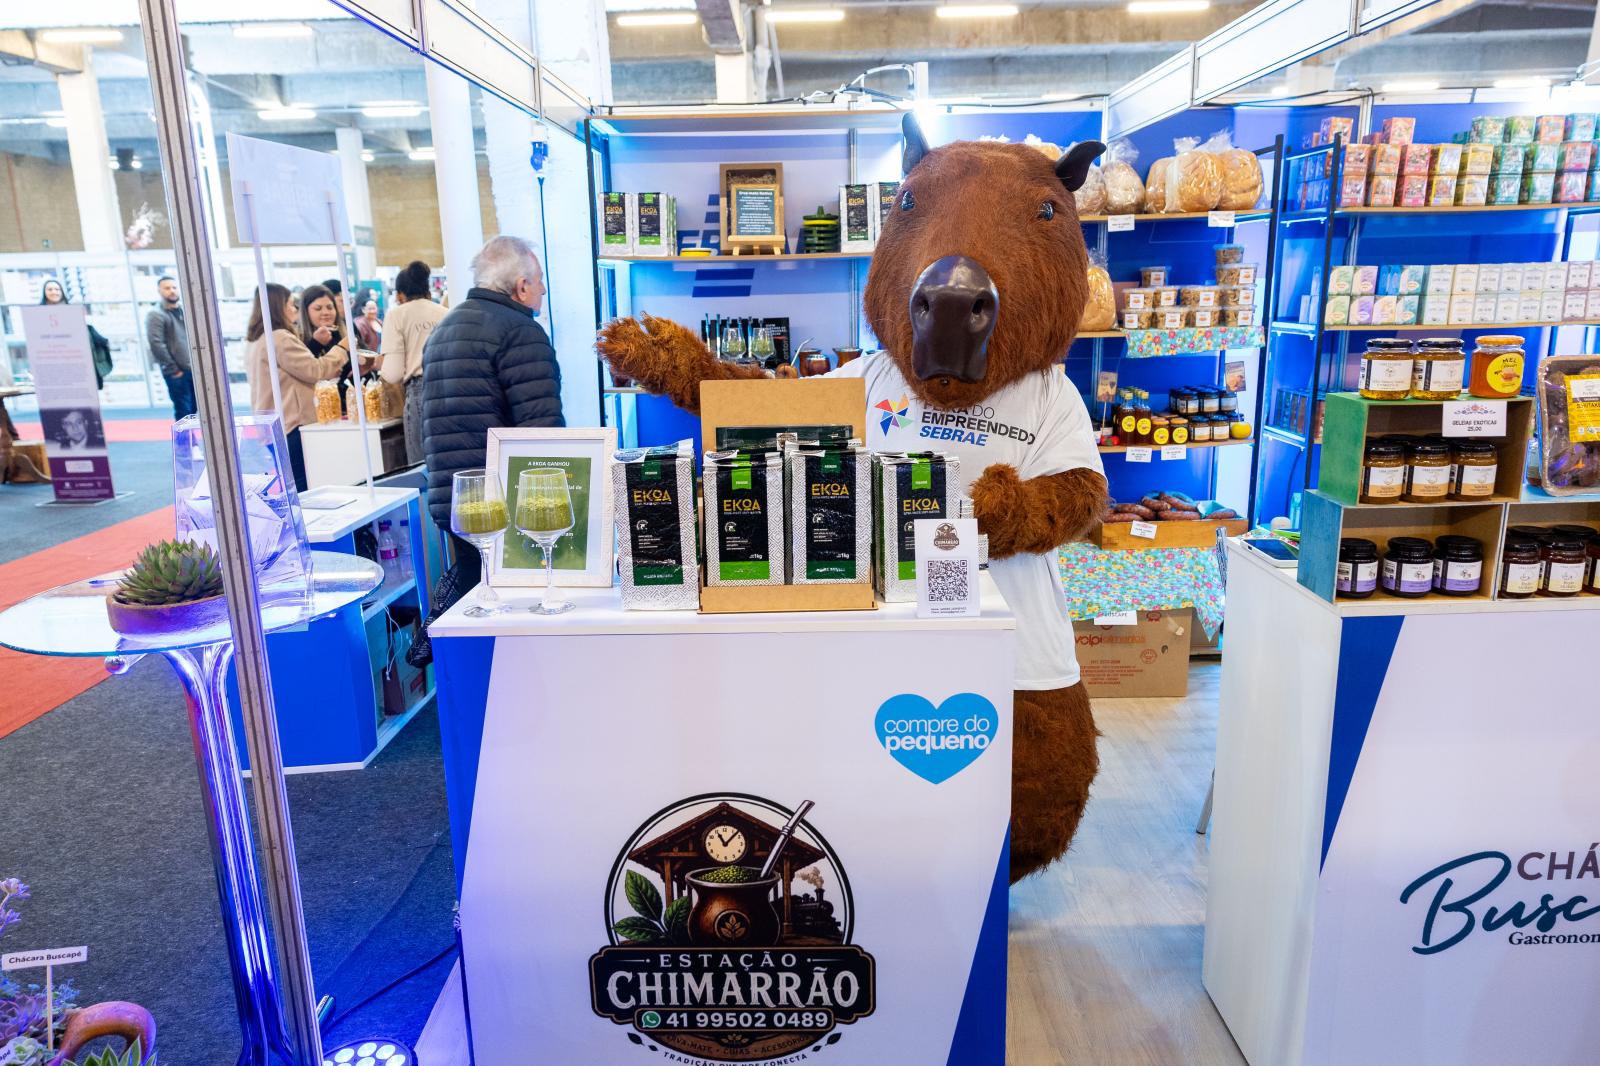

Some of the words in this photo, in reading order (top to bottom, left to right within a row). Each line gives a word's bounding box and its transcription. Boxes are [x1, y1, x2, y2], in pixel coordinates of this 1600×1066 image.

[972, 404, 995, 419] DO
[919, 425, 989, 447] SEBRAE
[633, 488, 673, 504] EKOA
[811, 483, 850, 496] EKOA
[723, 499, 761, 512] EKOA
[903, 498, 940, 512] EKOA
[884, 718, 959, 736] compre
[963, 714, 991, 732] do
[885, 734, 991, 755] pequeno
[8, 955, 45, 964] Chácara
[46, 951, 82, 961] Buscapé
[659, 951, 797, 971] ESTAÇÃO
[606, 966, 860, 1009] CHIMARRÃO
[666, 1012, 689, 1028] 41
[695, 1012, 767, 1028] 99502
[773, 1012, 829, 1028] 0489
